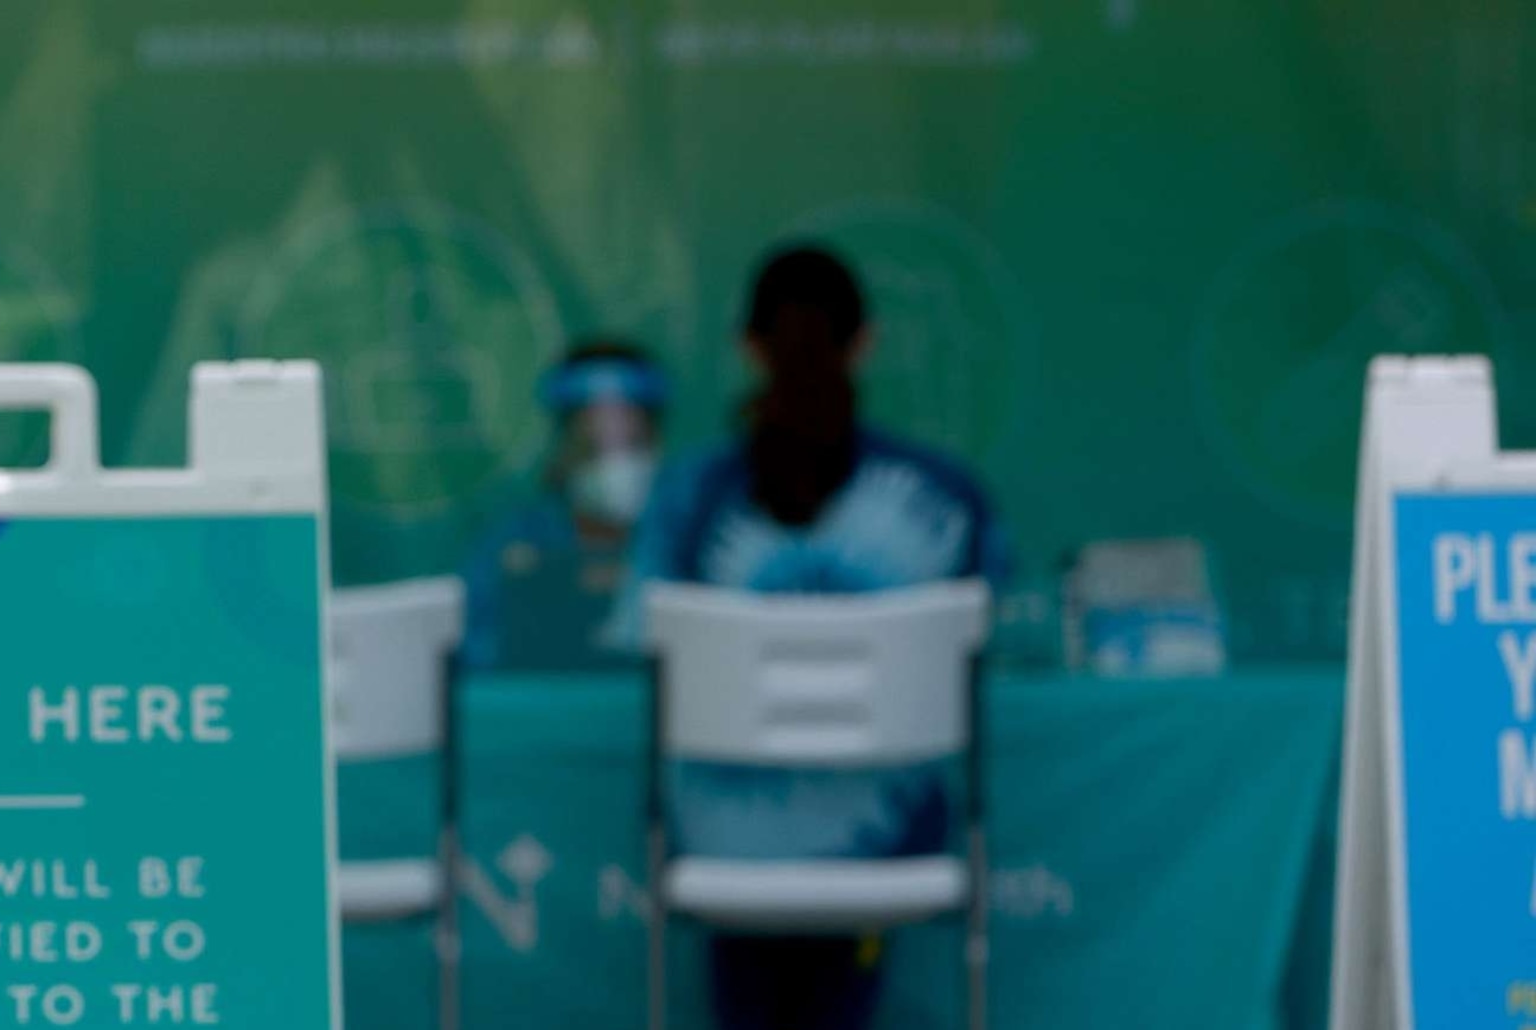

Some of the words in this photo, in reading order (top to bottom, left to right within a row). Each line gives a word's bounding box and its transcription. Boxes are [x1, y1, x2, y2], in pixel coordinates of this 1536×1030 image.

[28, 684, 232, 743] HERE
[138, 856, 205, 898] BE
[127, 919, 207, 961] TO
[7, 983, 85, 1025] TO
[111, 982, 219, 1024] THE
